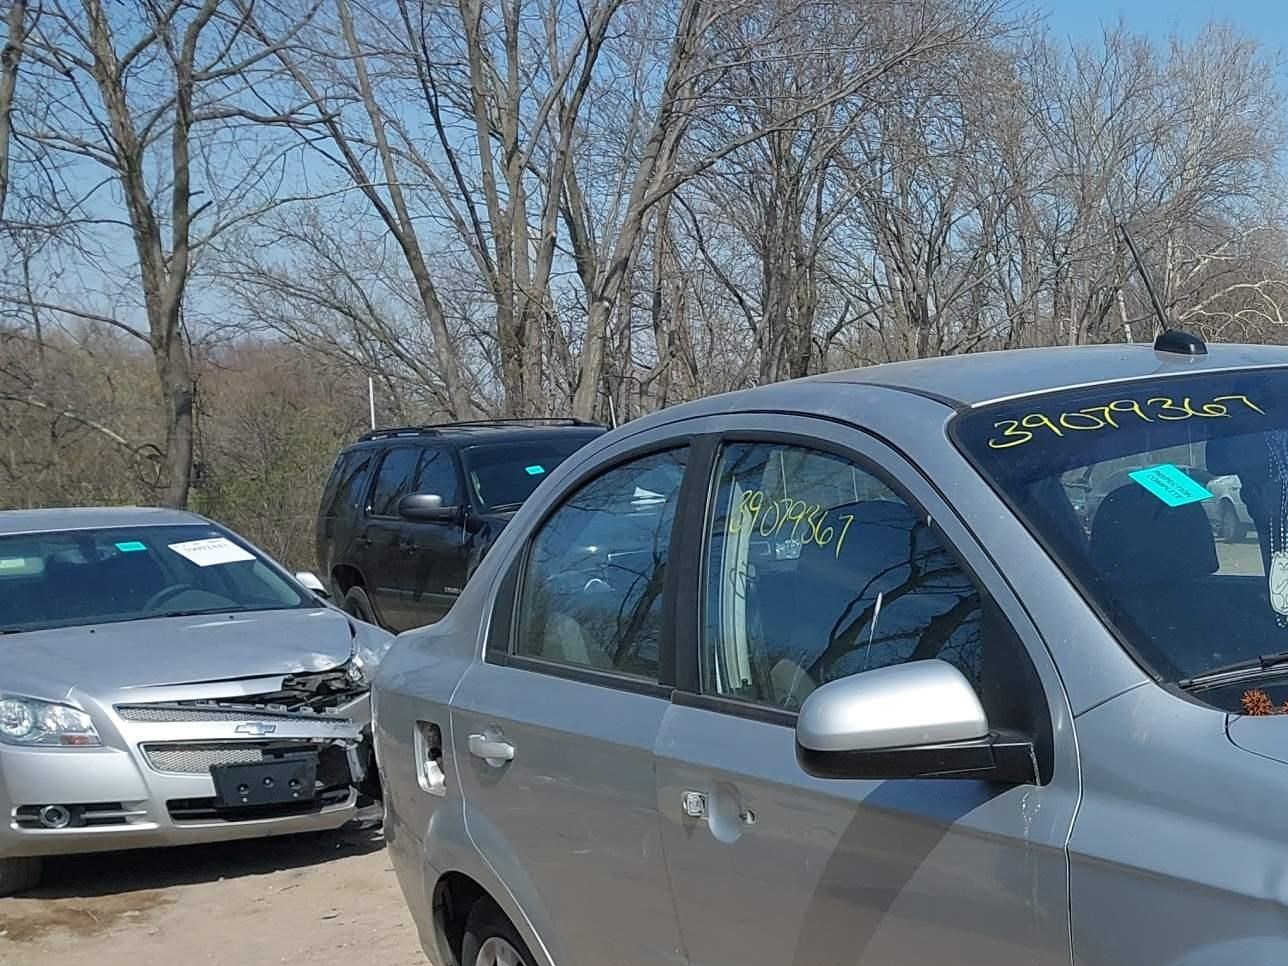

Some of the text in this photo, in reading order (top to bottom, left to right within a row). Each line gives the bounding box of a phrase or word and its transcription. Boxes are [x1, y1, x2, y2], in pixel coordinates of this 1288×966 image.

[987, 395, 1266, 449] 39079367
[1145, 473, 1183, 500] COMPLETE
[1151, 469, 1194, 498] INSPECTION
[730, 489, 855, 560] 39079367
